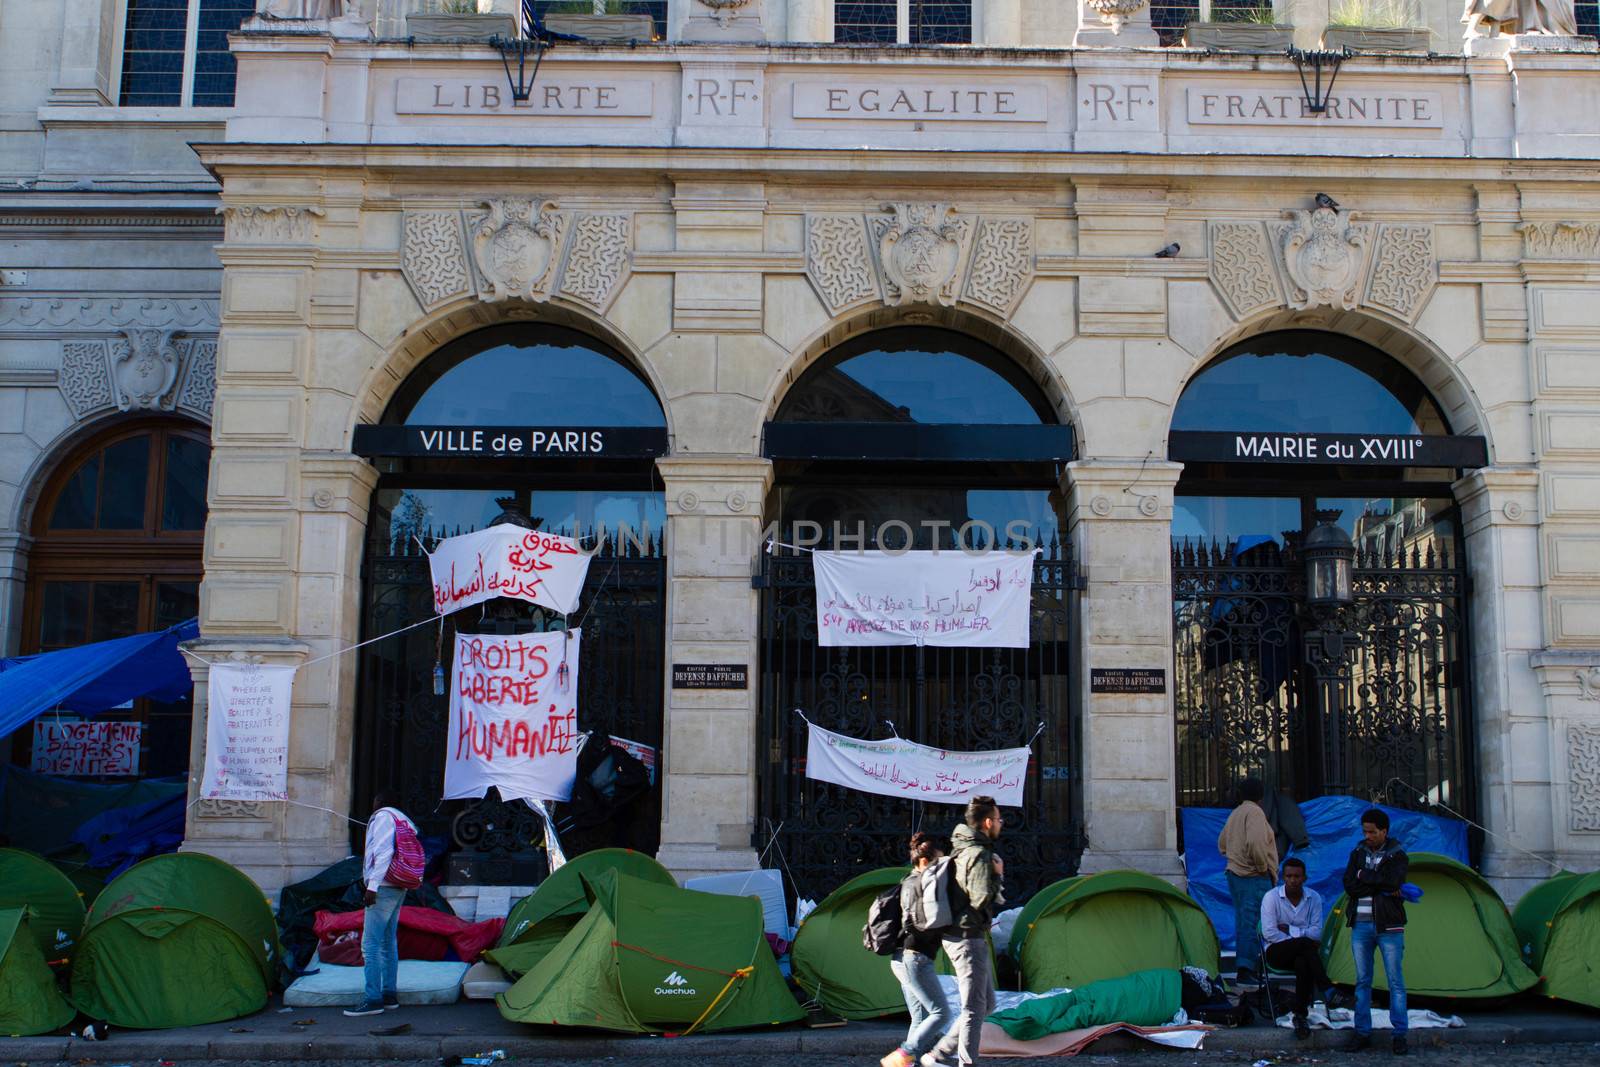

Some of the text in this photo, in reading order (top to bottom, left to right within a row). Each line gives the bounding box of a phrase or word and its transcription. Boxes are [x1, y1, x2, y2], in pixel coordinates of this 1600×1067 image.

[826, 88, 1017, 114] EGALITE
[1202, 94, 1432, 121] FRATERNITE
[420, 430, 604, 453] VILLE de PARIS
[1236, 436, 1318, 458] MAIRIE
[1325, 440, 1354, 459] du
[522, 531, 579, 557] حقوق
[508, 544, 553, 573] حرية
[654, 987, 696, 996] Quechua
